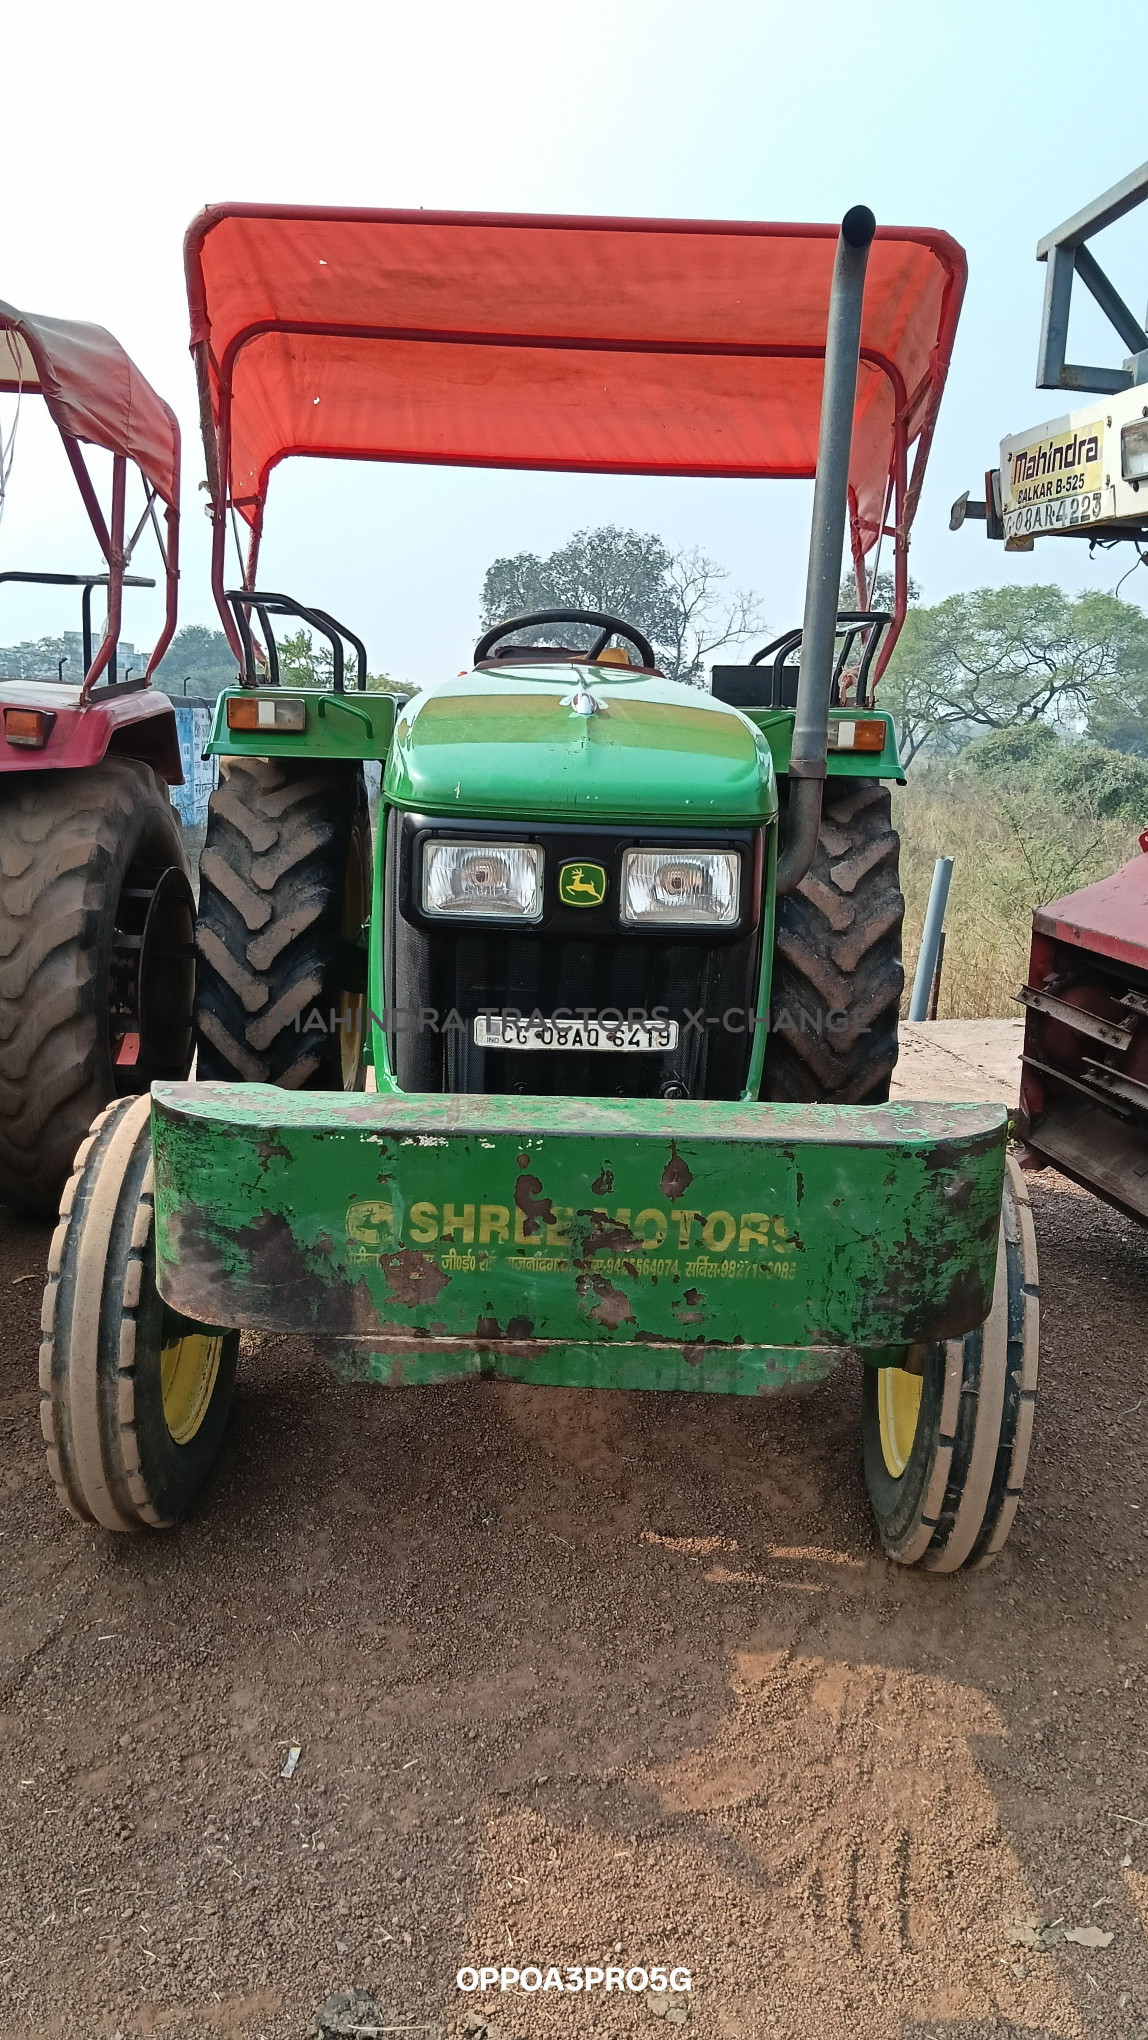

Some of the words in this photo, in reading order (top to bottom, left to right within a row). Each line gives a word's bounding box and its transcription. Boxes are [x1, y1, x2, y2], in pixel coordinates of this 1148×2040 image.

[1012, 433, 1099, 486] Mahindra
[1056, 473, 1085, 495] B-525
[486, 1036, 500, 1044] IND
[502, 1025, 528, 1044] CG
[612, 1027, 670, 1048] 6419
